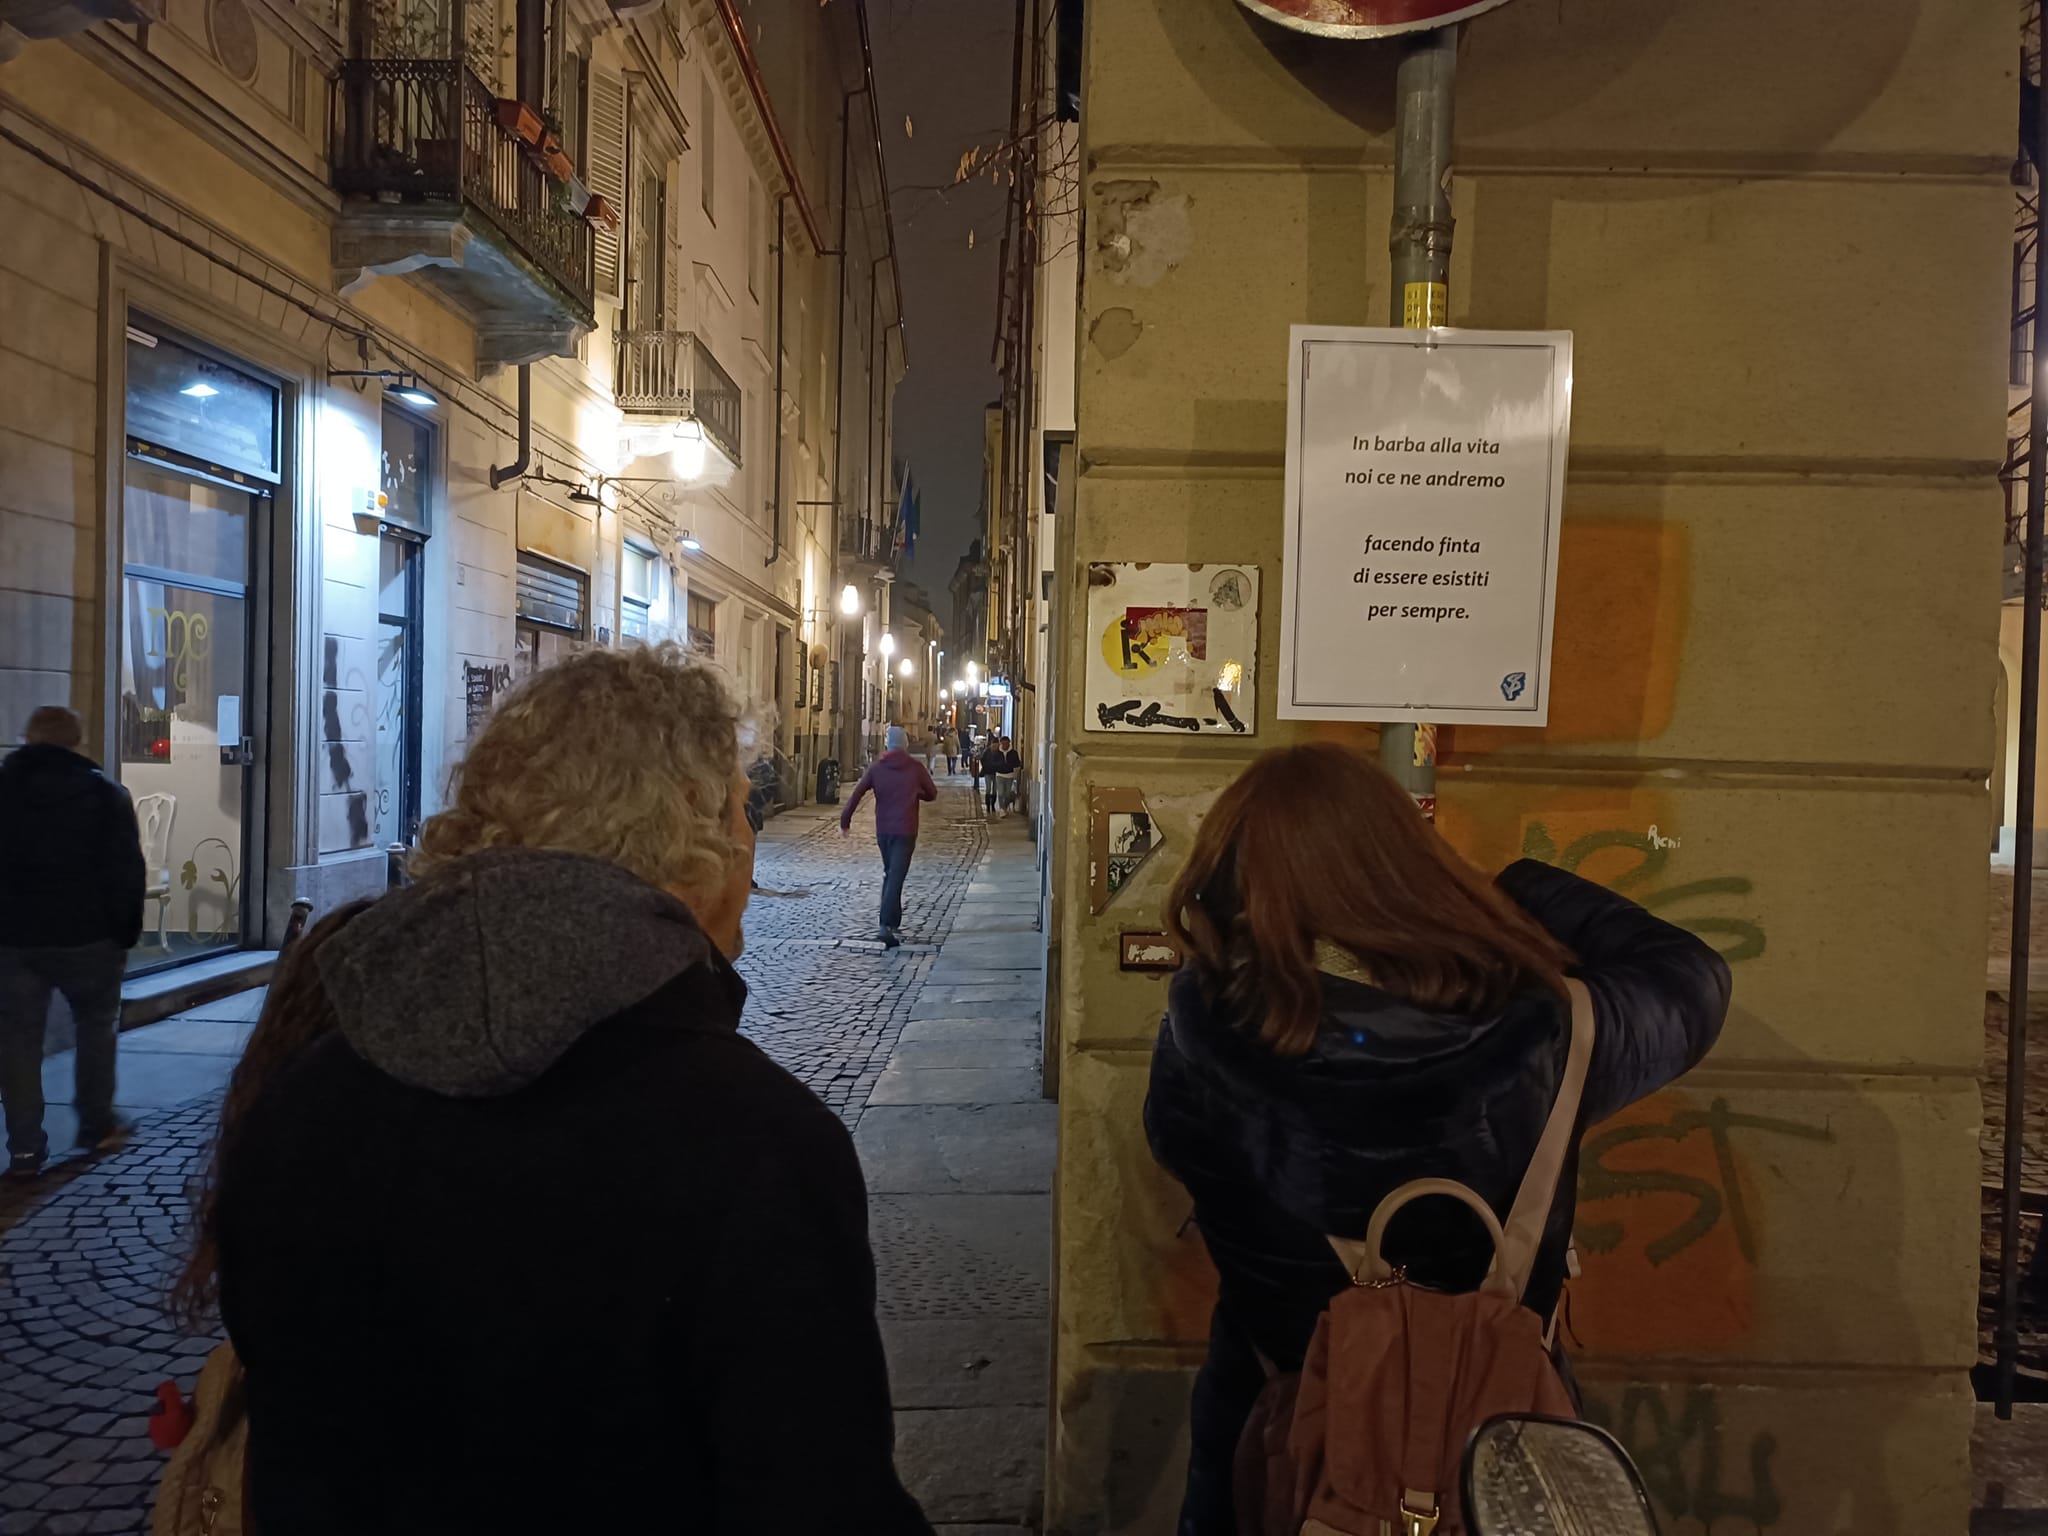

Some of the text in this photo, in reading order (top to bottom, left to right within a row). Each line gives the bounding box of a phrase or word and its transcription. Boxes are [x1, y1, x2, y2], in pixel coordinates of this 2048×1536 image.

[1352, 435, 1500, 454] In barba alla vita
[1345, 468, 1505, 488] noi ce ne andremo
[1364, 534, 1481, 557] facendo finta
[1353, 567, 1489, 587] di essere esistiti
[1368, 604, 1470, 623] per sempre.
